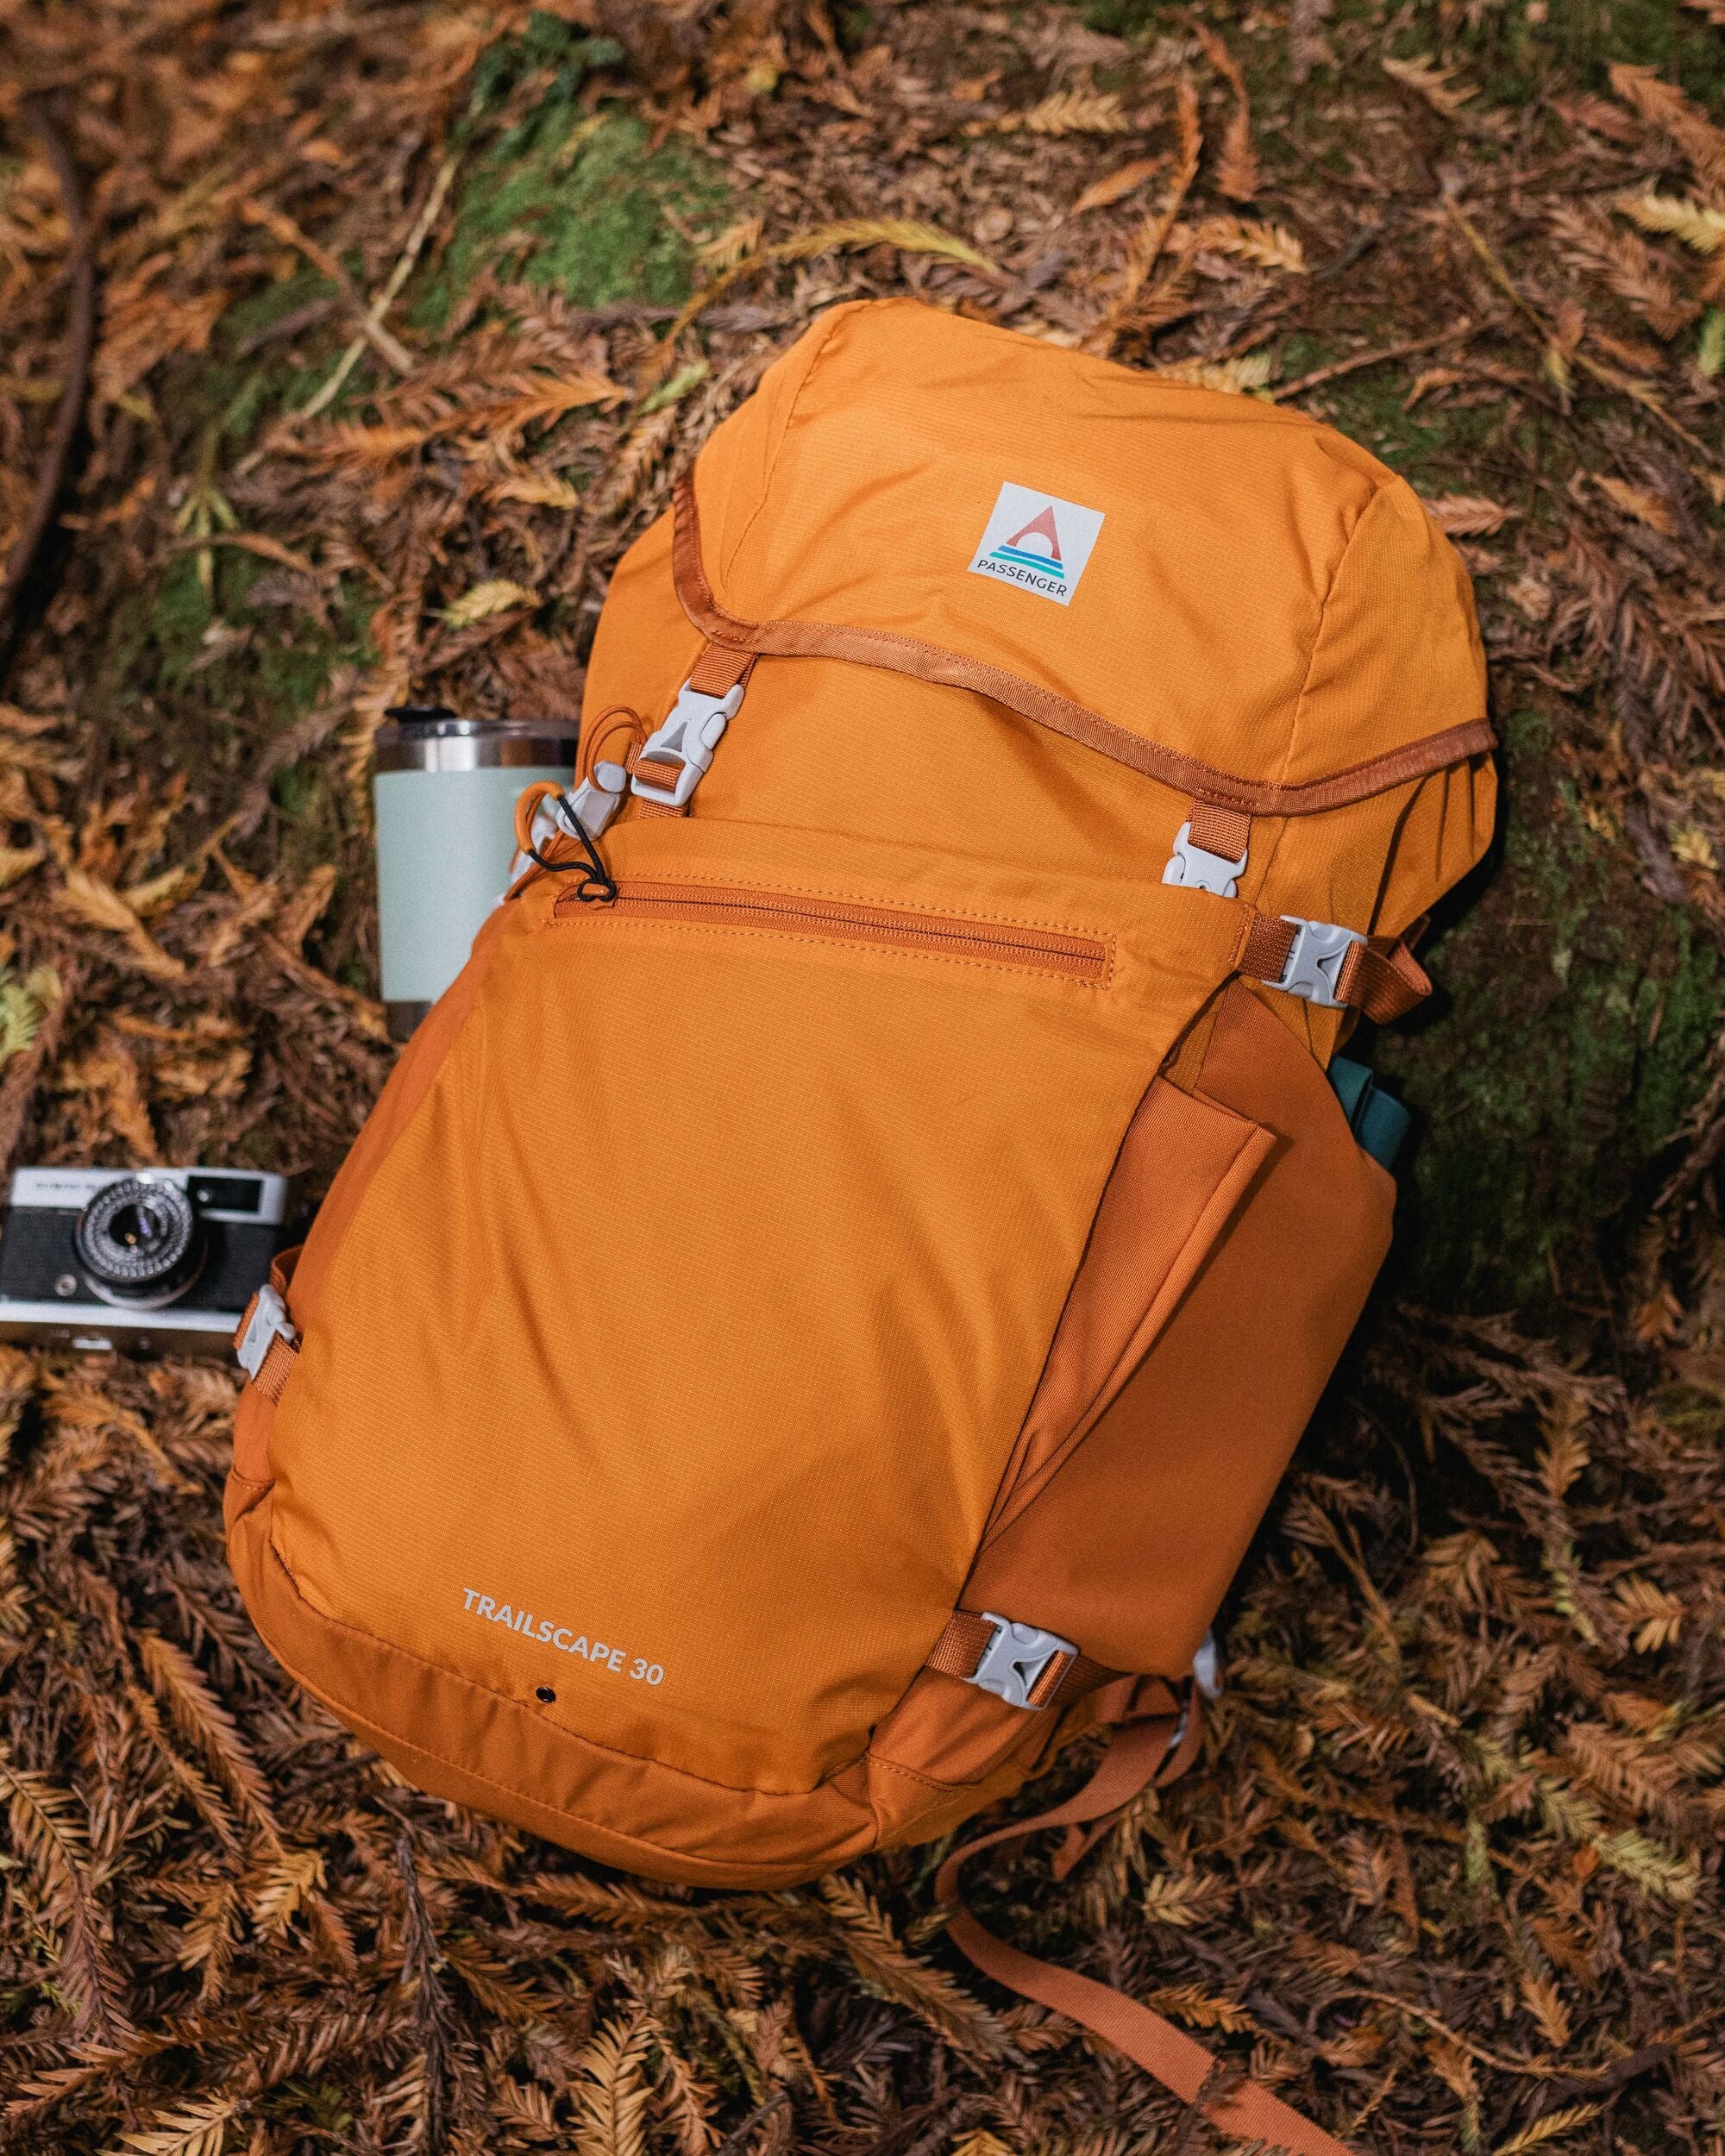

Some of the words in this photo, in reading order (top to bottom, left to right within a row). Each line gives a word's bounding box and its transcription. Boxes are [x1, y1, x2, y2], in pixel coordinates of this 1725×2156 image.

[977, 560, 1067, 597] PASSENGER
[462, 1587, 626, 1672] TRAILSCAPE
[629, 1658, 664, 1686] 30
